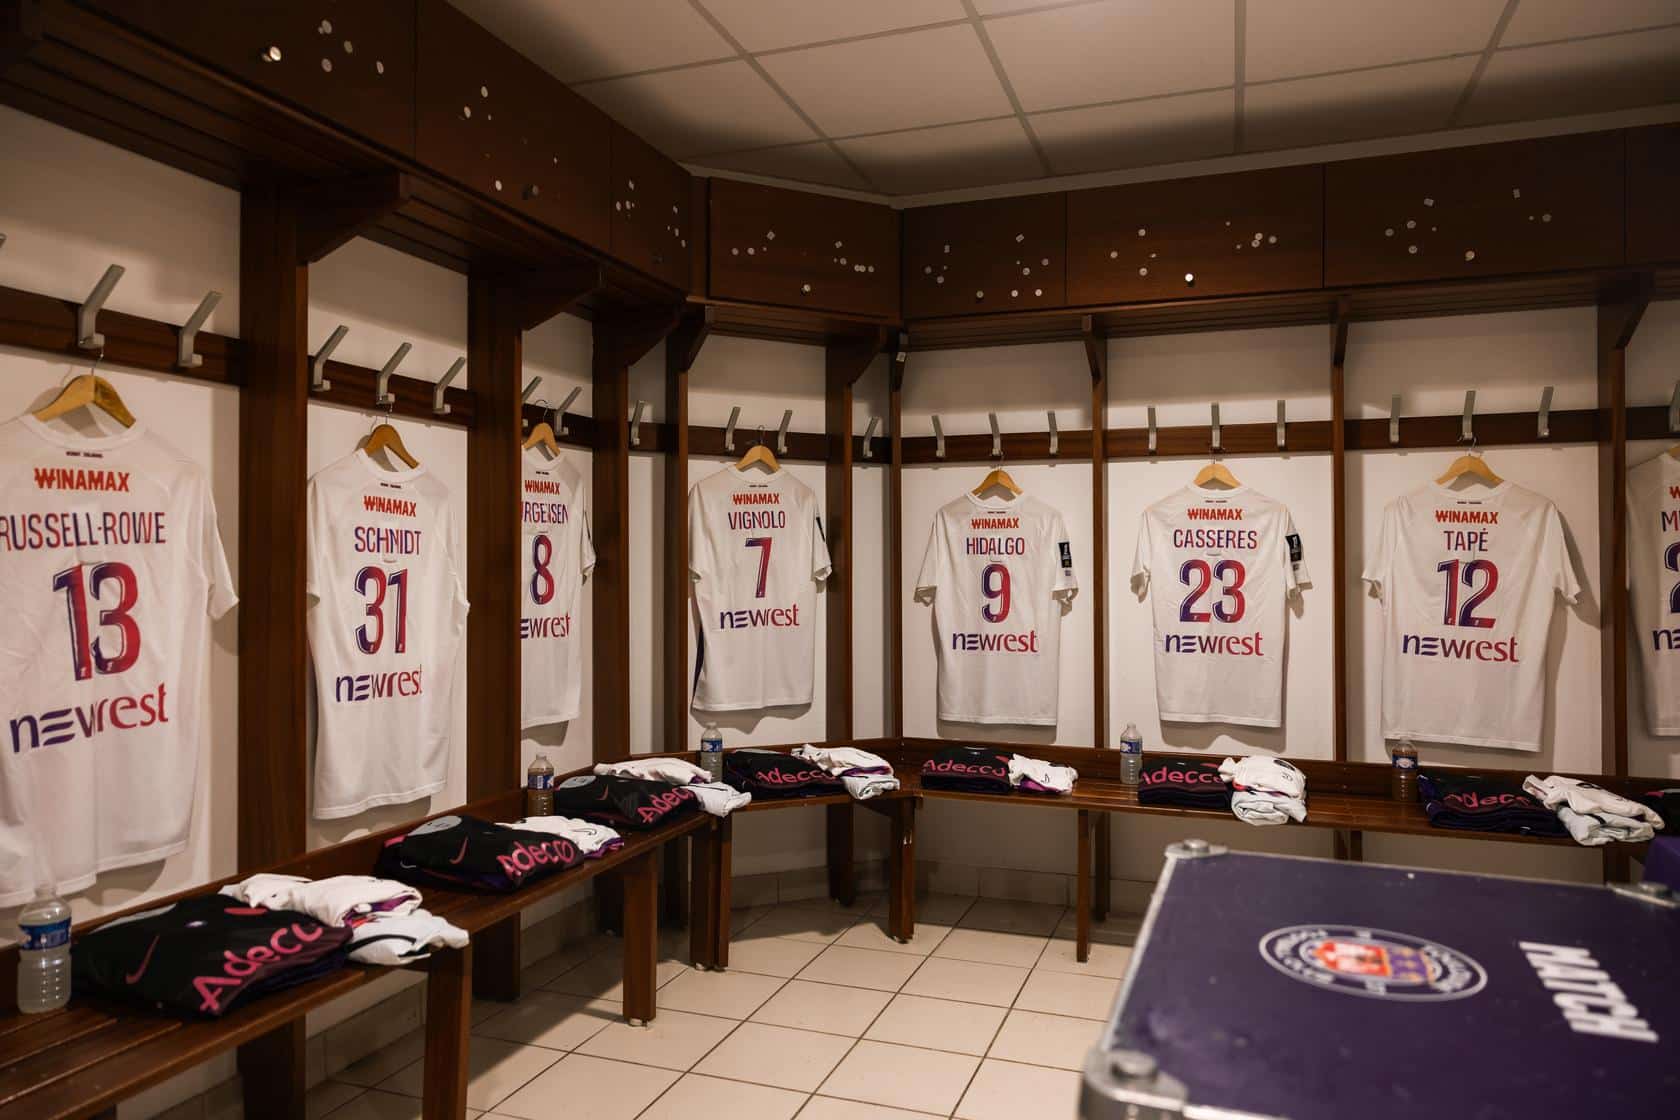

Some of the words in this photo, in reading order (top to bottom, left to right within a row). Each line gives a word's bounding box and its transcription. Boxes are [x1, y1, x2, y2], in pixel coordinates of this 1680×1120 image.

[34, 467, 130, 492] WINAMAX
[524, 479, 560, 495] WINAMAX
[364, 495, 417, 518] WINAMAX
[733, 493, 780, 505] WINAMAX
[728, 510, 786, 530] VIGNOLO
[971, 517, 1019, 529] WINAMAX
[1187, 508, 1242, 521] WINAMAX
[1435, 510, 1499, 524] WINAMAX
[0, 511, 166, 551] RUSSELL-ROWE
[1173, 529, 1258, 549] CASSERES
[966, 537, 1025, 556] HIDALGO
[530, 534, 555, 605] 8
[745, 537, 772, 598] 7
[981, 563, 1011, 623] 9
[1179, 559, 1246, 623] 23
[1437, 558, 1499, 629] 12
[53, 562, 141, 681] 13
[354, 566, 408, 655] 31
[719, 603, 800, 629] newrest
[520, 611, 571, 638] ewrest
[952, 630, 1038, 653] newrest
[1165, 632, 1265, 656] newrest
[1402, 635, 1519, 662] newrest
[1518, 940, 1660, 1043] MATCH
